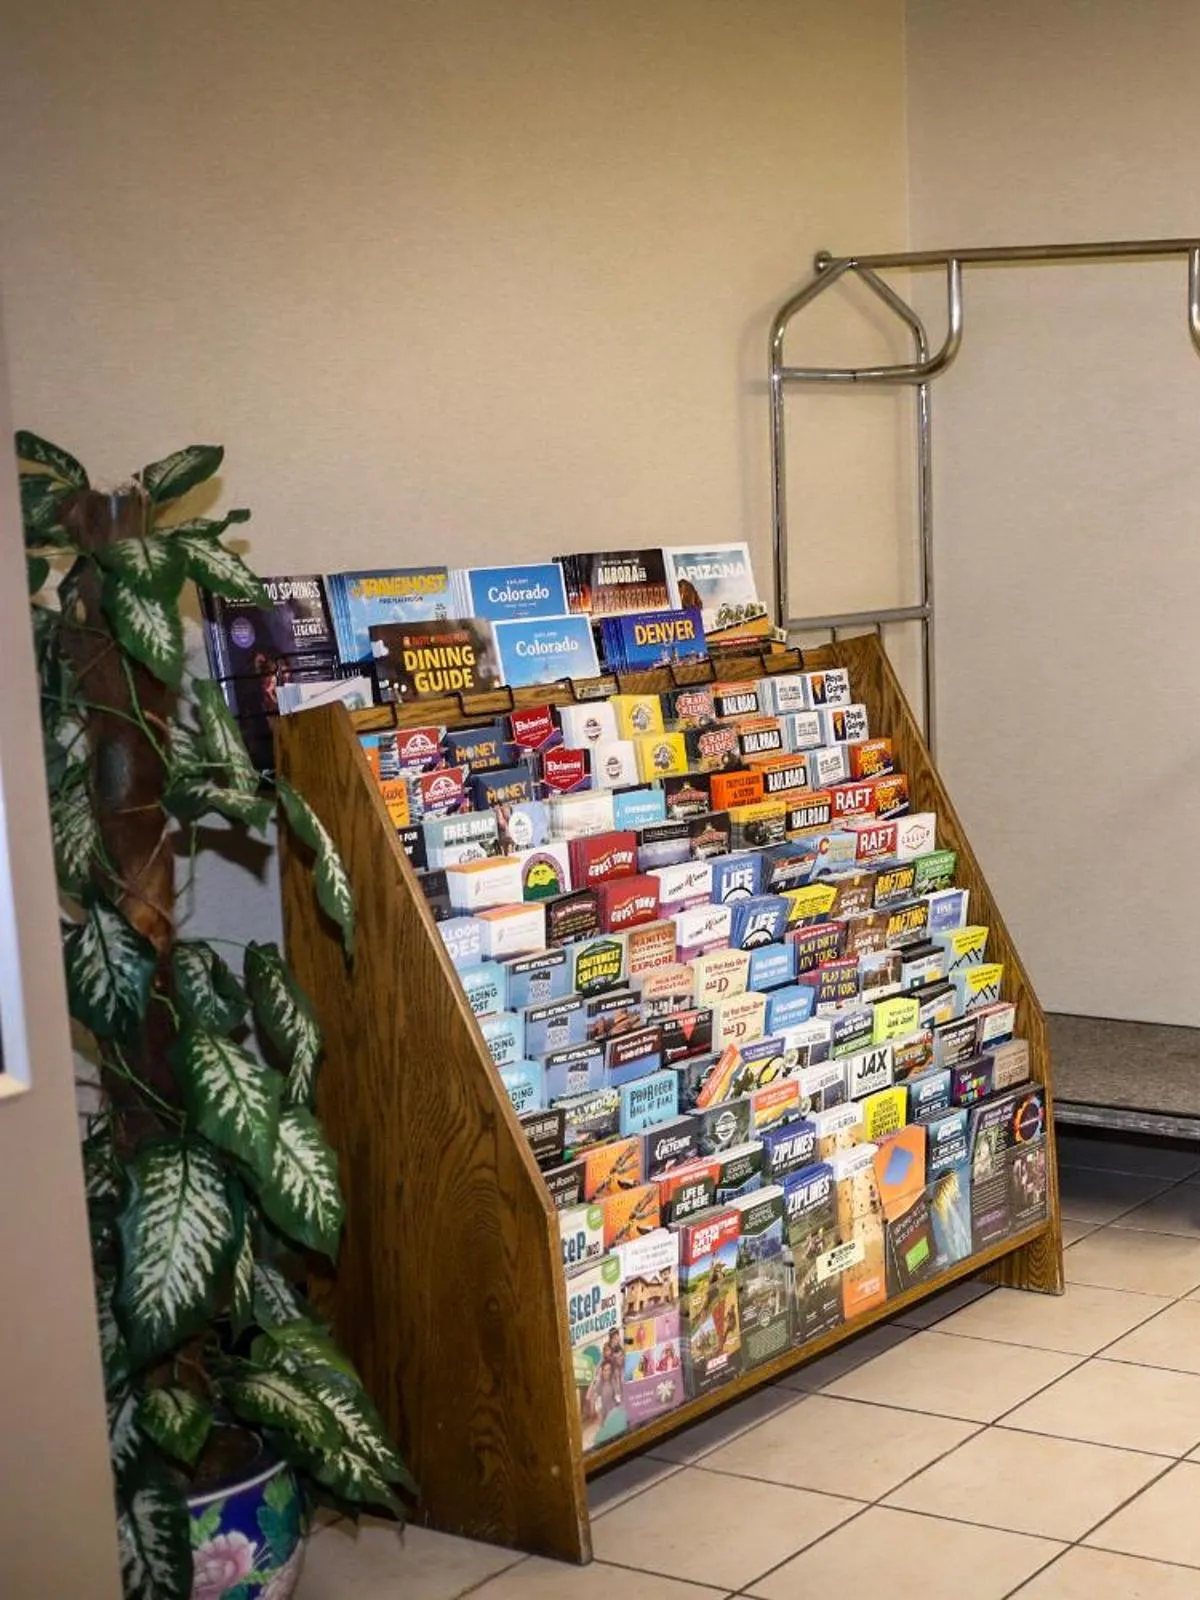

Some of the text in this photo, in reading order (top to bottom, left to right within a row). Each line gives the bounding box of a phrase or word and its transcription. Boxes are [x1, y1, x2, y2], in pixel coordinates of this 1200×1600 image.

[677, 561, 747, 580] ARIZONA
[278, 580, 321, 600] SPRINGS
[487, 583, 551, 603] Colorado
[634, 619, 695, 647] DENVER
[515, 635, 579, 657] Colorado
[403, 644, 477, 672] DINING
[413, 667, 475, 693] GUIDE
[455, 742, 497, 763] MONEY
[486, 781, 527, 803] MONEY
[835, 788, 873, 811] RAFT
[442, 822, 471, 841] FREE
[859, 827, 895, 853] RAFT
[588, 856, 612, 877] GHOST
[721, 868, 754, 890] LIFE
[609, 905, 635, 923] GHOST
[747, 910, 779, 933] LIFE
[631, 954, 674, 974] EXPLORE
[469, 987, 498, 1002] ADING
[488, 1036, 516, 1052] ADING
[856, 1049, 889, 1080] JAX
[511, 1086, 534, 1102] DING
[771, 1133, 815, 1166] ZIPLINES
[787, 1176, 831, 1214] ZIPLINES
